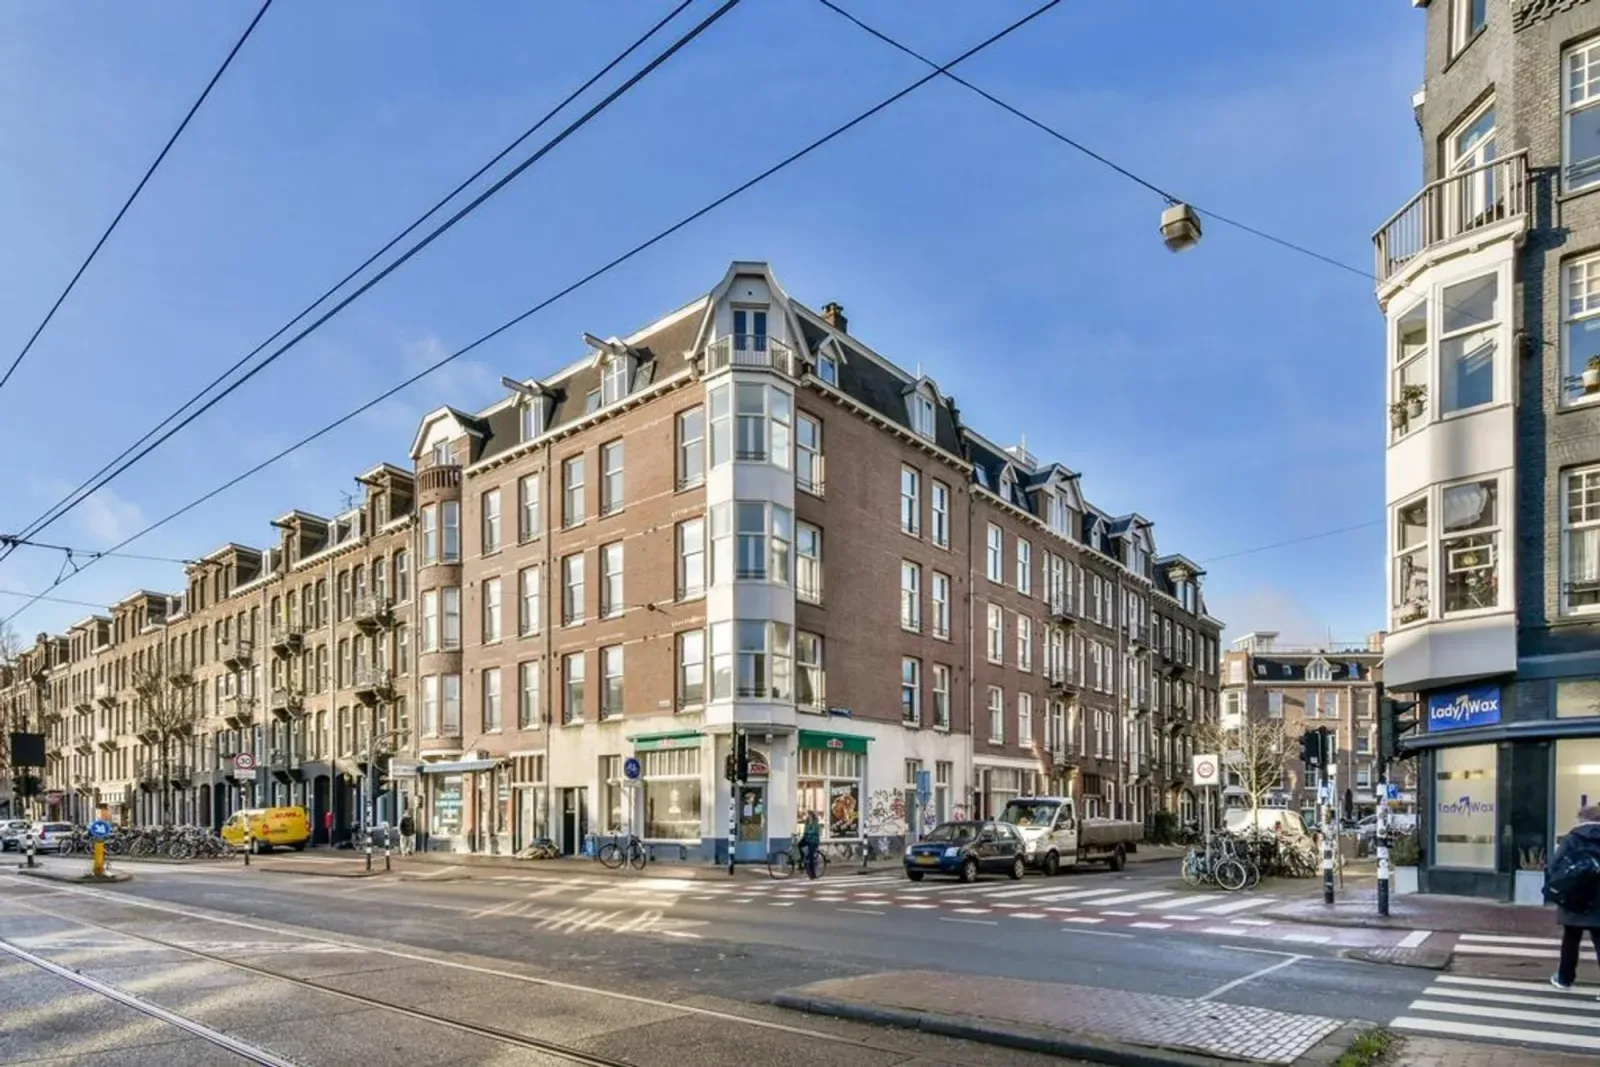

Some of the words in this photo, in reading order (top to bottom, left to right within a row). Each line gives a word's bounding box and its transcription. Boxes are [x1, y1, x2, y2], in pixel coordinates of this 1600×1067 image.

[1431, 703, 1459, 719] Lady
[1469, 700, 1498, 714] Wax
[240, 757, 251, 765] 30
[1470, 801, 1495, 813] Wax
